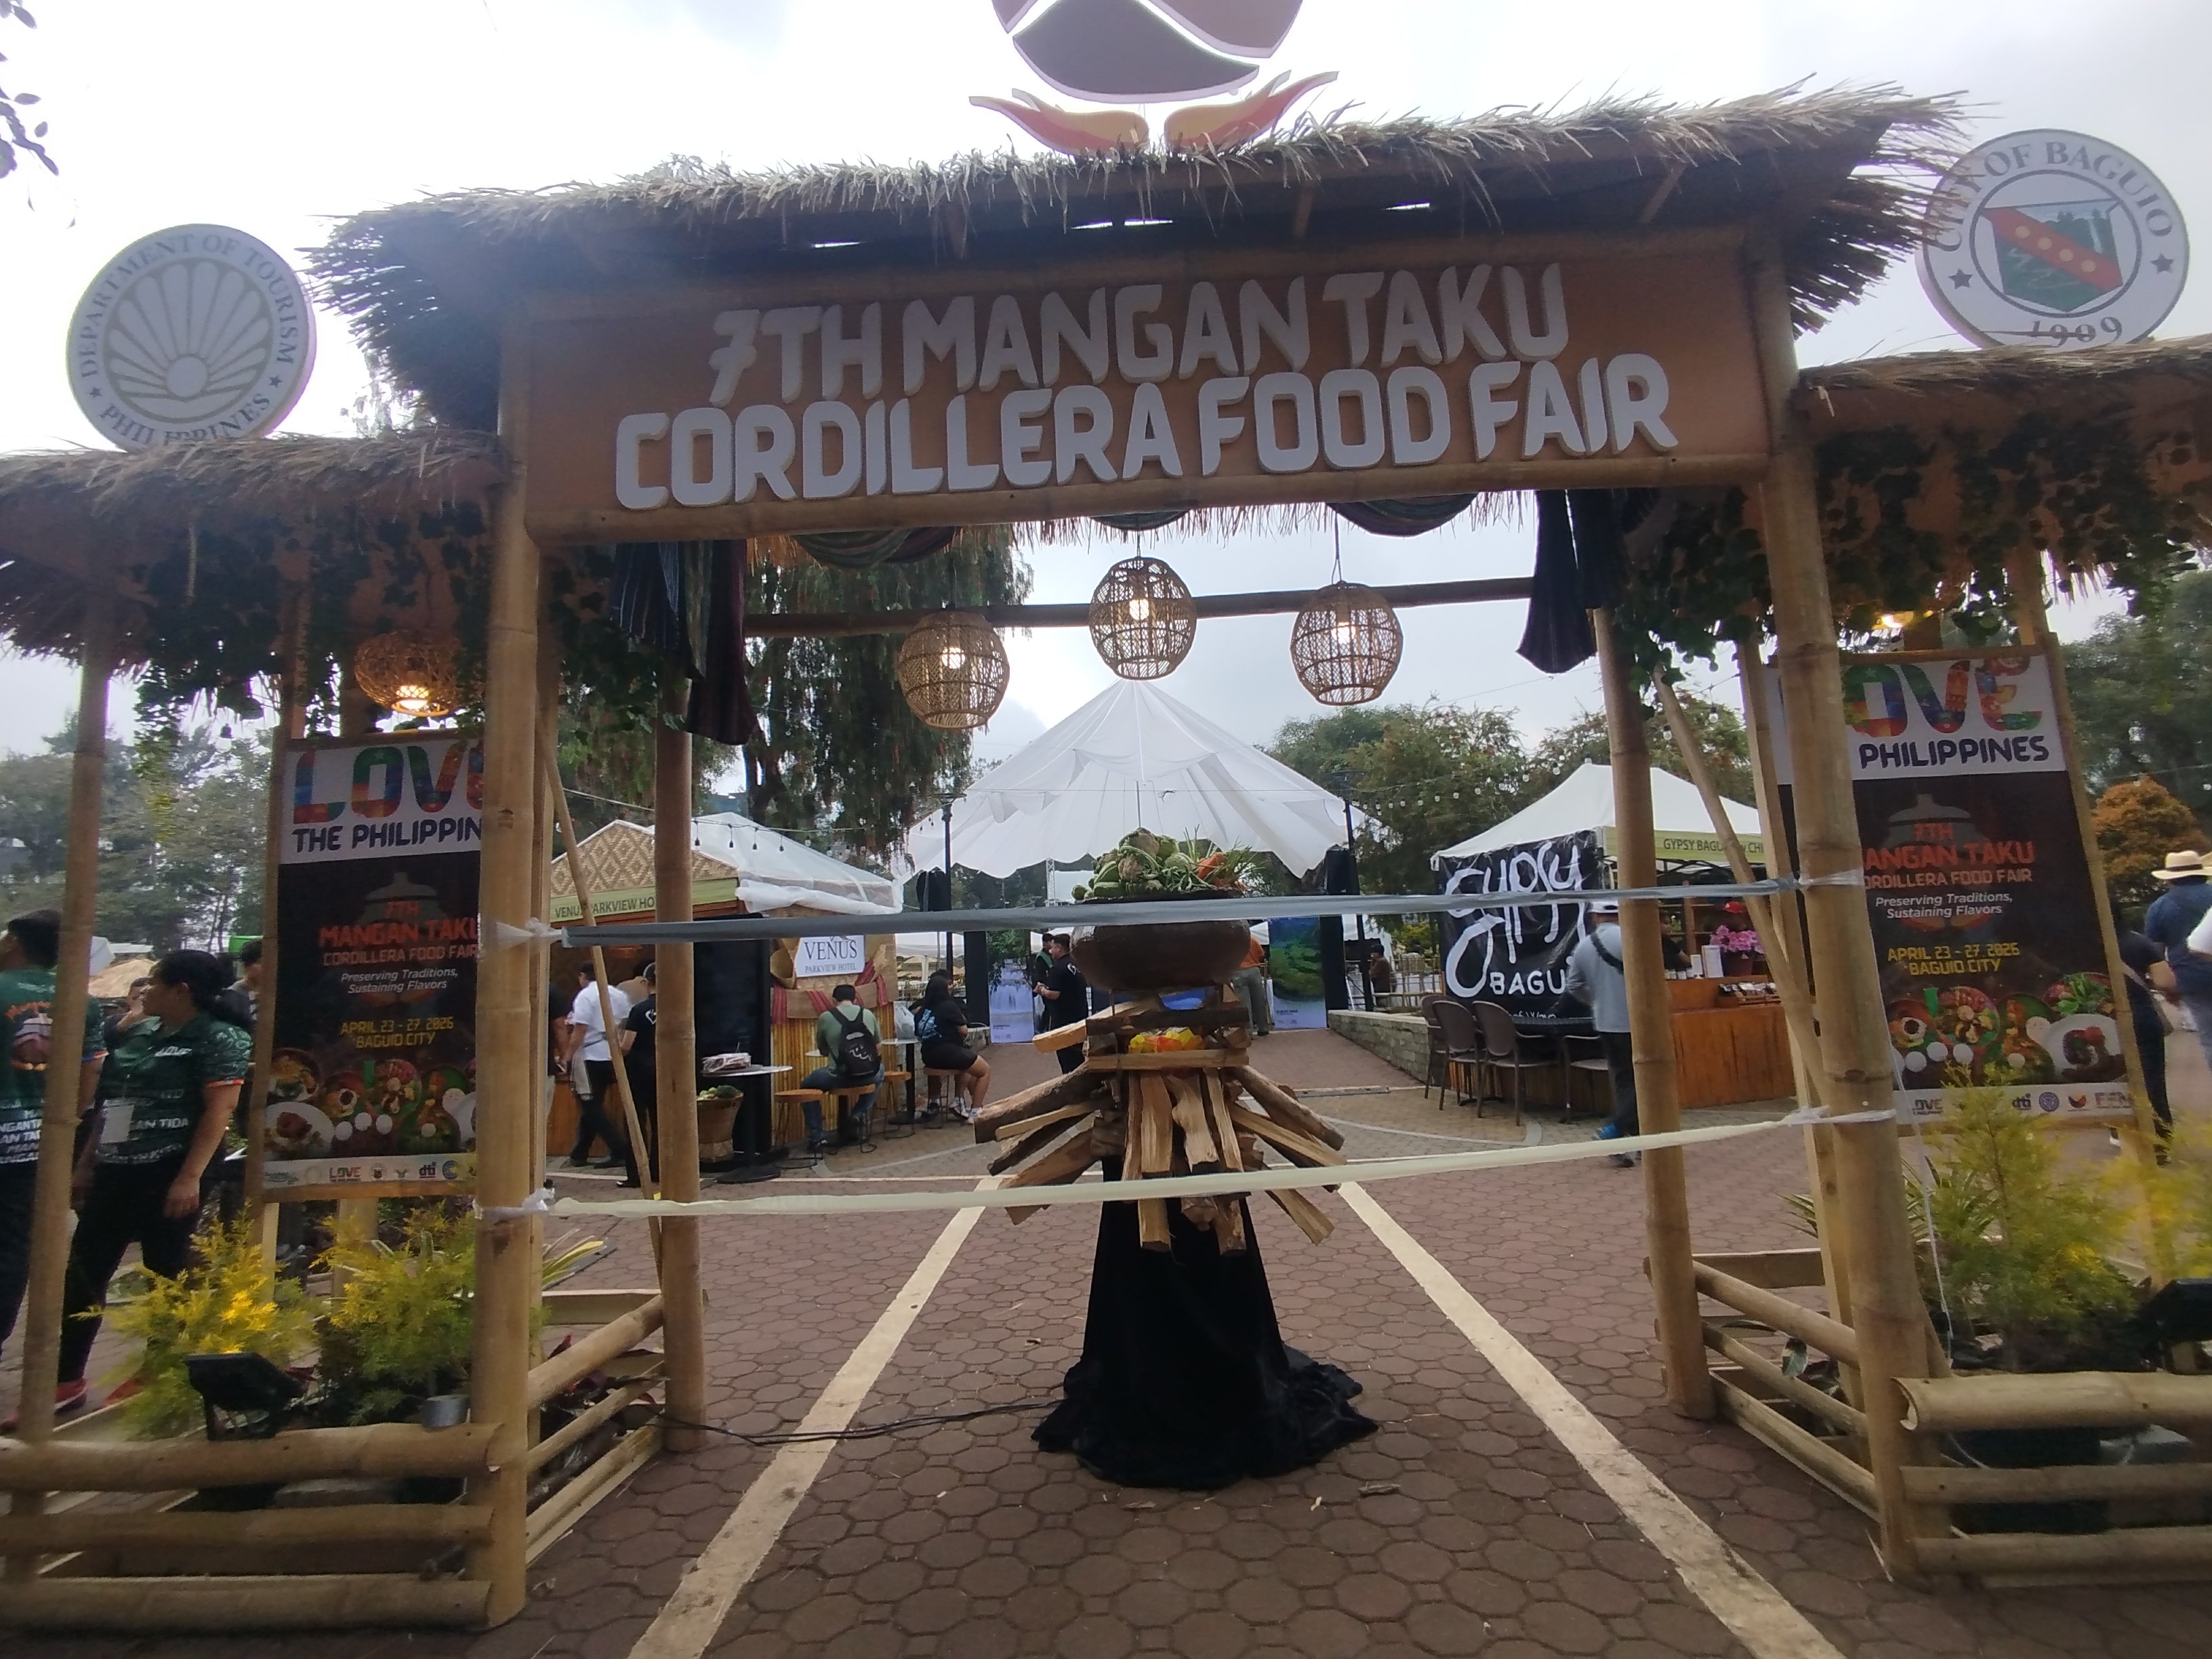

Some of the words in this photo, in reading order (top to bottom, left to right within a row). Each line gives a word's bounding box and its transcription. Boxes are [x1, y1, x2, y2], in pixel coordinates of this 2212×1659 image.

[1984, 144, 2032, 177] OF
[2045, 141, 2173, 237] BAGUIO
[79, 233, 194, 378] DEPARTMENT
[203, 234, 242, 255] OF
[243, 246, 299, 365] TOURISM
[710, 301, 883, 406] 7TH
[903, 276, 1311, 398] MANGAN
[1322, 262, 1570, 369] TAKU
[2033, 316, 2123, 347] 1909
[616, 382, 1183, 511] CORDILLERA
[1197, 365, 1452, 478] FOOD
[1469, 352, 1679, 461] FAIR
[1843, 655, 2043, 738] OVE
[1859, 735, 2050, 769] PHILIPPINES
[292, 825, 344, 853] THE
[1914, 822, 1954, 840] 7TH
[1664, 838, 1695, 851] GYPSY
[1864, 844, 1959, 870] ANGAN
[1963, 840, 2035, 865] TAKU
[1950, 869, 1992, 885] FOOD
[1996, 867, 2033, 884] FAIR
[592, 898, 638, 914] ARKVIEW
[1875, 895, 1943, 908] Preserving
[1946, 891, 2013, 905] Traditions,
[1887, 906, 1952, 920] Sustaining
[1956, 905, 2003, 916] Flavors
[319, 922, 419, 948] MANGAN
[323, 948, 406, 967] CORDILLERA
[409, 946, 446, 962] FOOD
[804, 940, 857, 961] VENUS
[1887, 947, 1931, 962] APRIL
[1933, 945, 1952, 960] 23
[341, 970, 398, 983] Preserving
[403, 966, 459, 979] Traditions,
[804, 964, 836, 973] PARKVIEW
[838, 962, 857, 971] HOTEL
[1909, 960, 1965, 976] BAGUIO
[1967, 958, 2001, 973] CITY
[347, 981, 405, 994] Sustaining
[407, 979, 447, 990] Flavors
[340, 1021, 376, 1036] APRIL
[381, 1020, 394, 1033] 23
[355, 1033, 403, 1049] BAGUIO
[407, 1031, 436, 1046] CITY
[329, 1166, 363, 1179] LOVE
